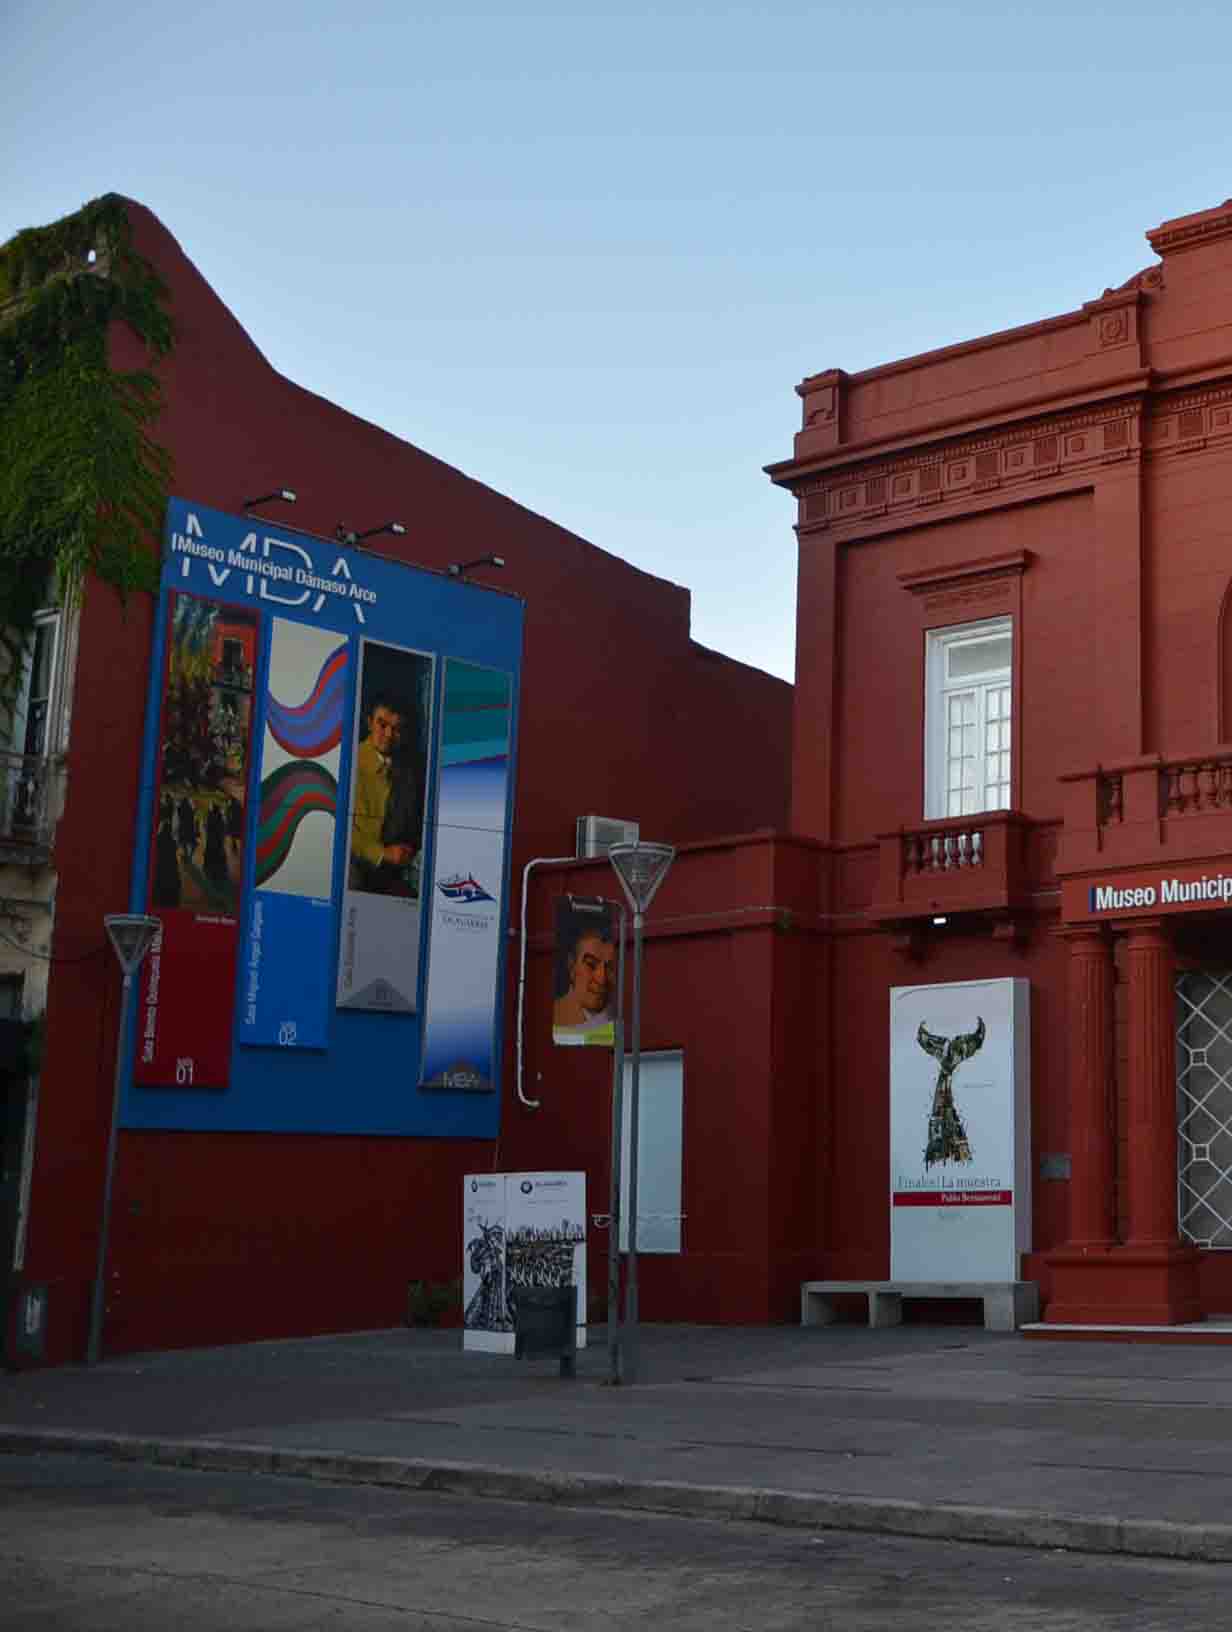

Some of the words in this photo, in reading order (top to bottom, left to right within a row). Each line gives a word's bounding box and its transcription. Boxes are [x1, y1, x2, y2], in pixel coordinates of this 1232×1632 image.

[178, 534, 225, 563] Museo
[228, 548, 293, 581] Municipal
[295, 568, 347, 596] Dámaso
[349, 582, 377, 604] Arce
[1095, 886, 1156, 910] Museo
